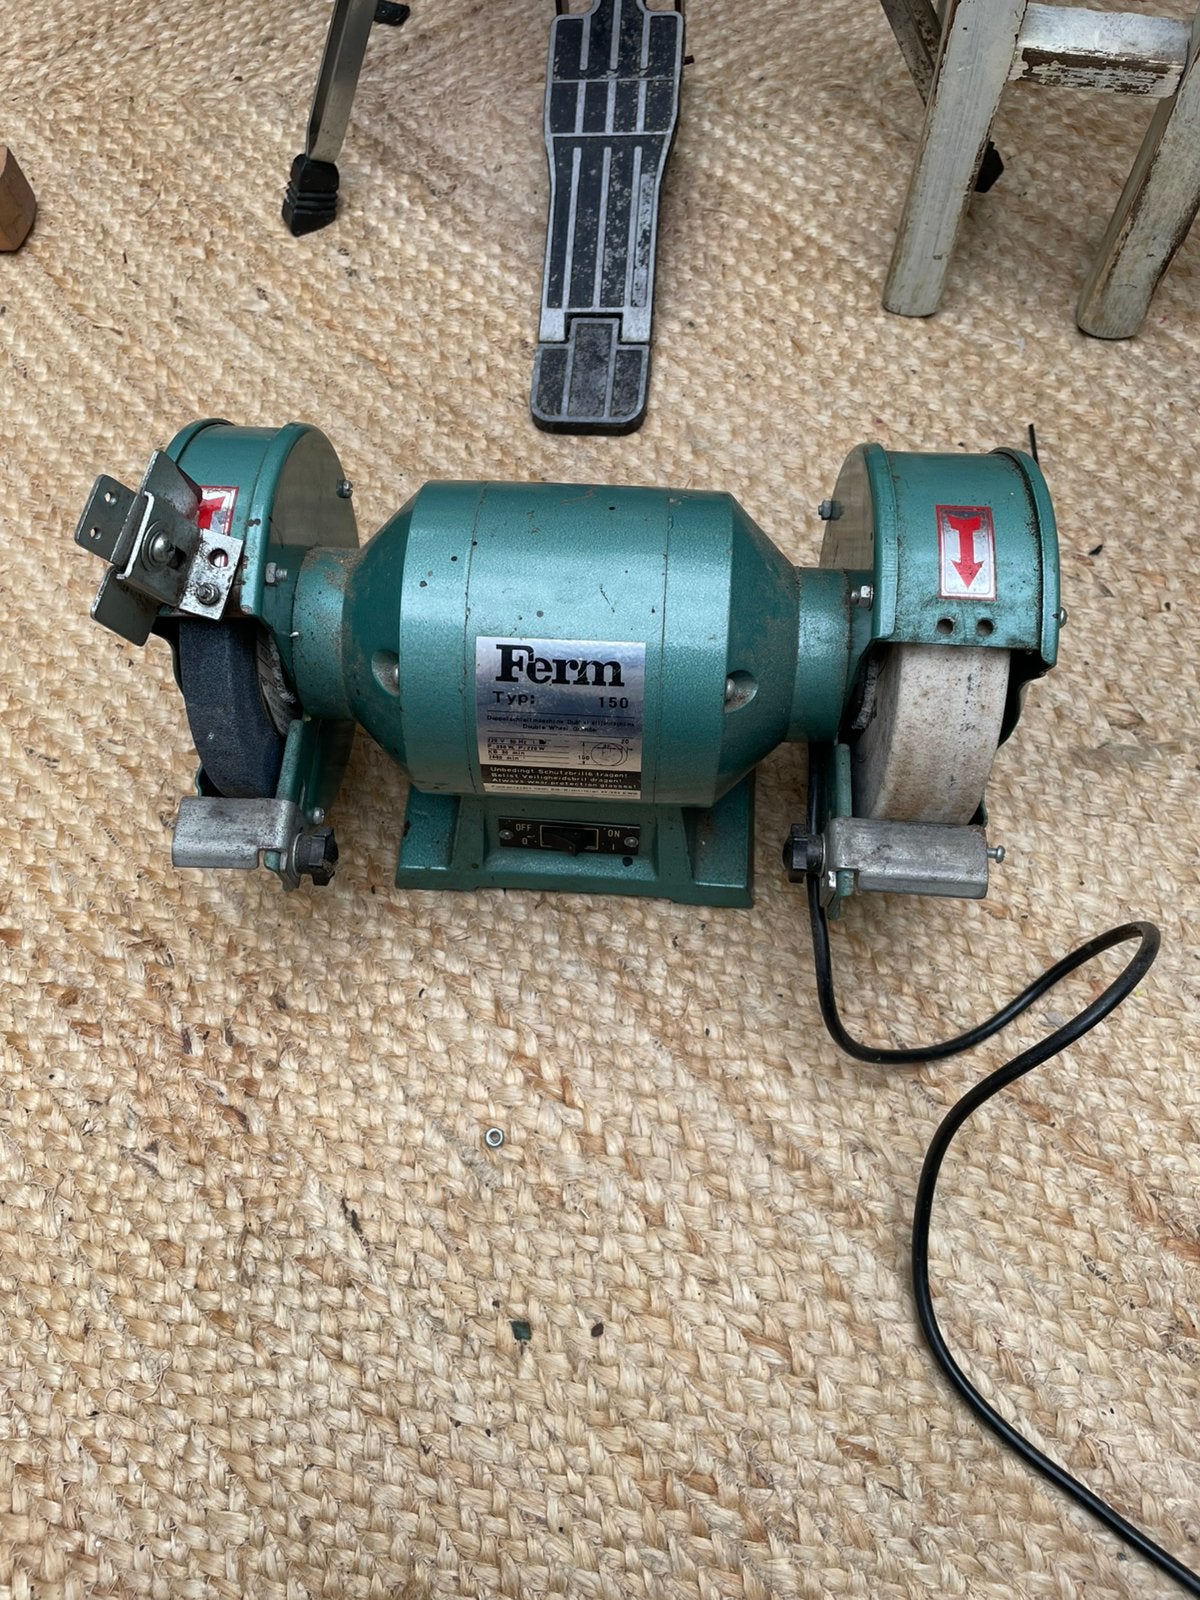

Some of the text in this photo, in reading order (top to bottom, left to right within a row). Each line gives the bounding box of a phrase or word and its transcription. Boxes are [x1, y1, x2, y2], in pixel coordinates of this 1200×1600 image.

[496, 644, 625, 687] Ferm
[493, 691, 629, 709] Typ: 150
[515, 823, 532, 832] OFF
[607, 829, 620, 838] ON
